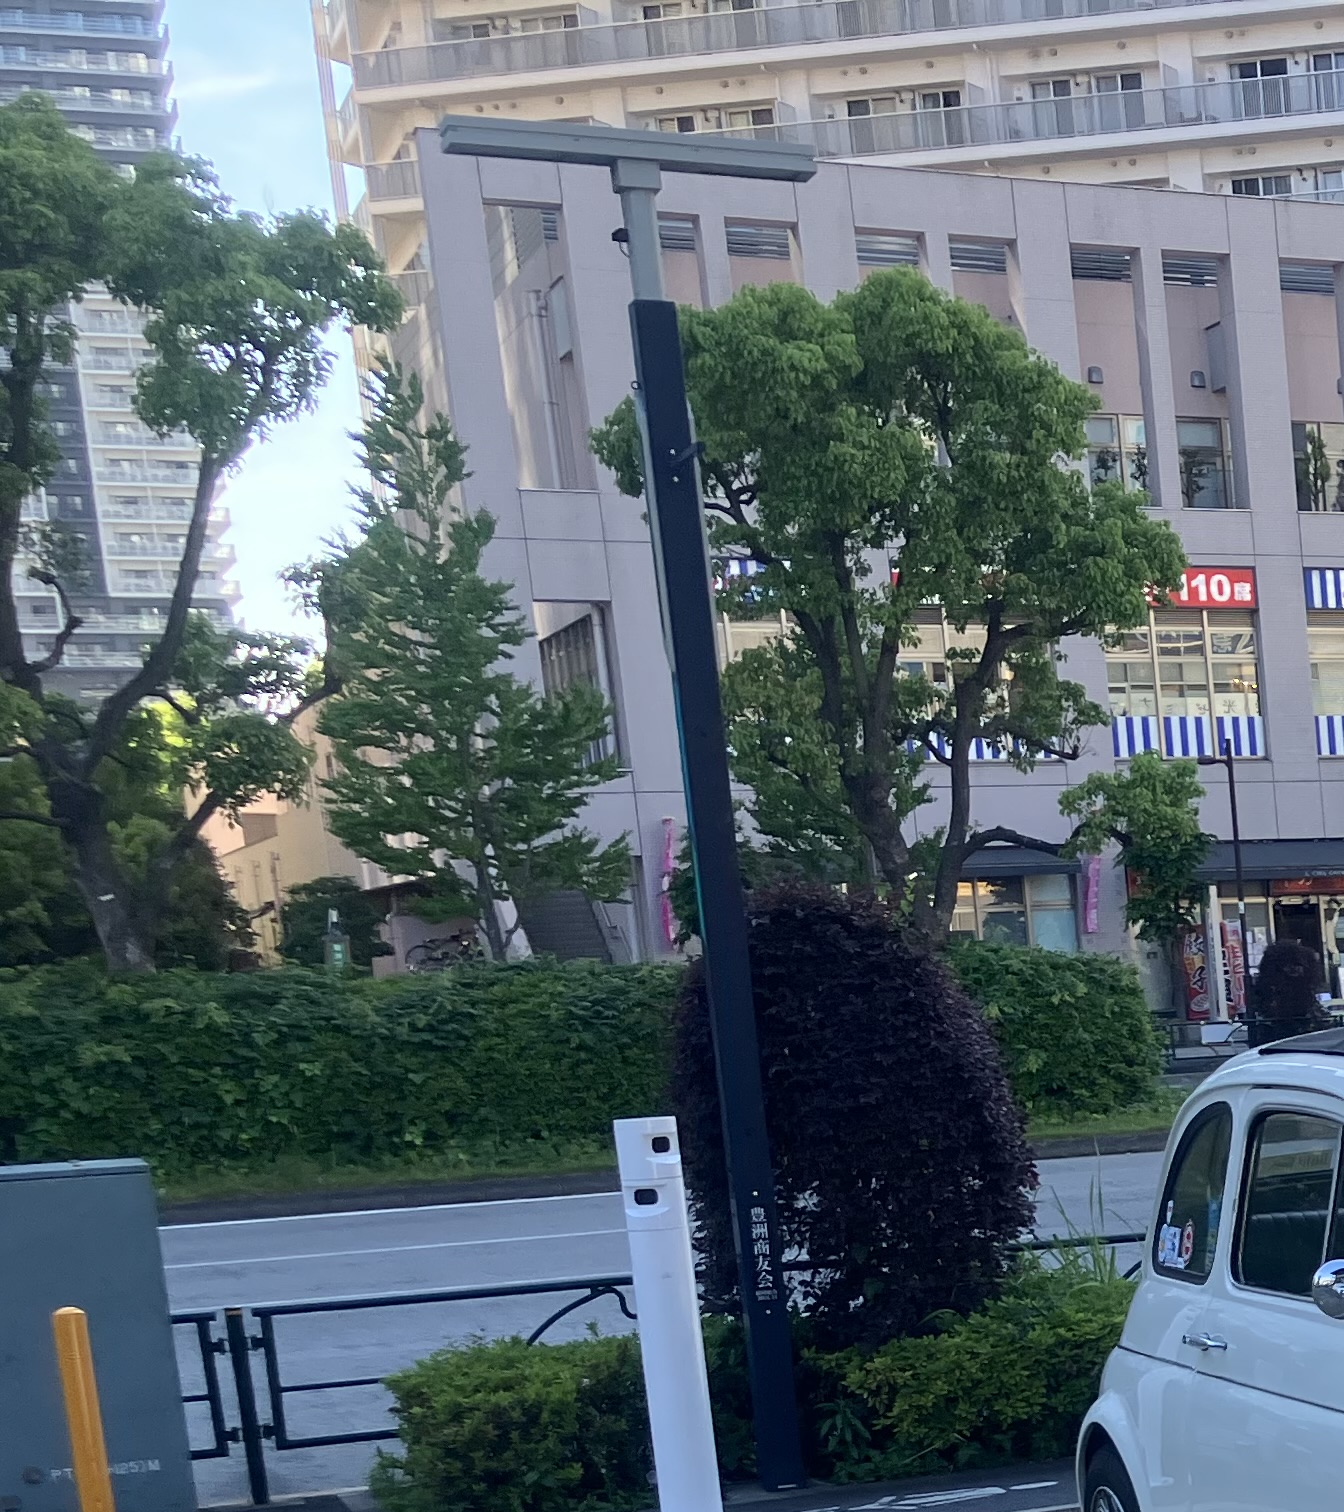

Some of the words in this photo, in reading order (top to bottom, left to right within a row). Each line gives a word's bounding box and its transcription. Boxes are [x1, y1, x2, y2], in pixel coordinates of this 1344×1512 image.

[750, 1207, 774, 1288] 豊洲商友会
